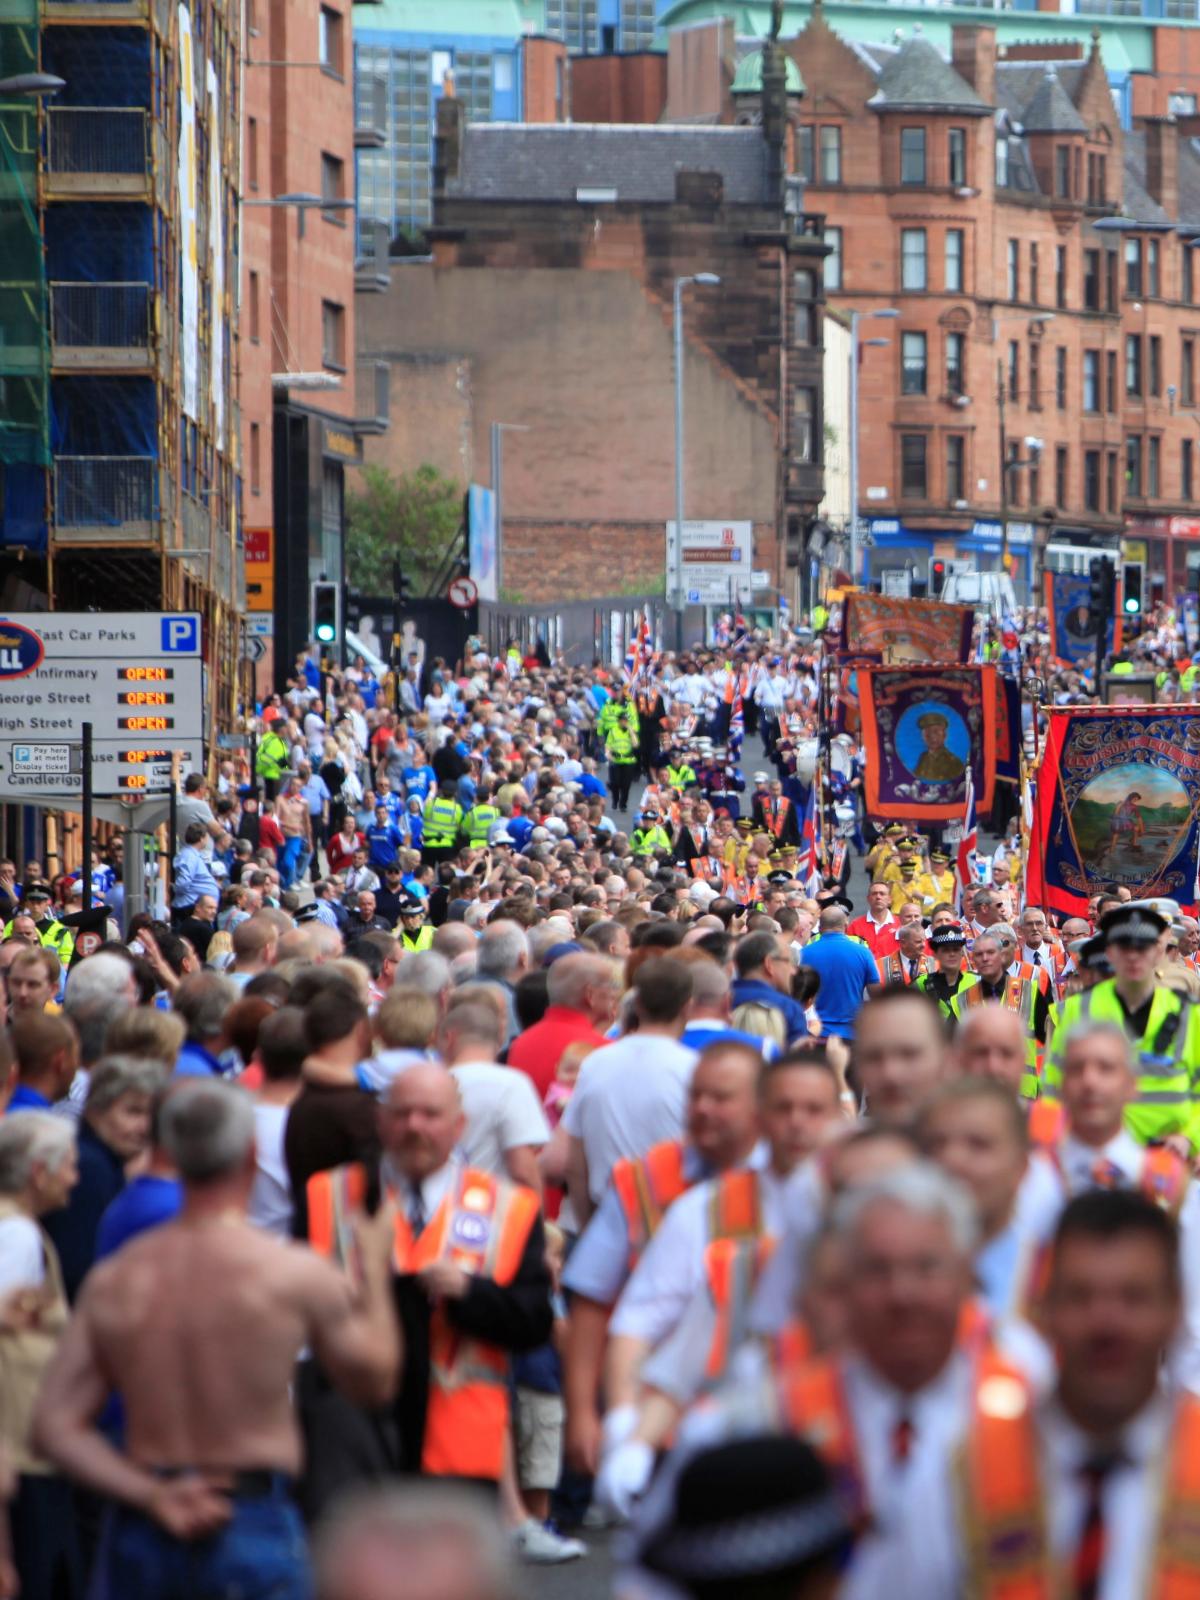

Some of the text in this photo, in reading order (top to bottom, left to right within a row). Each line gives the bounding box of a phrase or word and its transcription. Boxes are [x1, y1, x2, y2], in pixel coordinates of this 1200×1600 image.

[69, 629, 92, 641] Car
[99, 629, 136, 641] Parks
[169, 620, 192, 649] P
[36, 667, 166, 681] Infirmary OPEN
[48, 692, 91, 704] Street
[126, 692, 166, 705] OPEN
[30, 717, 73, 729] Street
[127, 716, 167, 730] OPEN
[8, 773, 82, 787] Candlerigg
